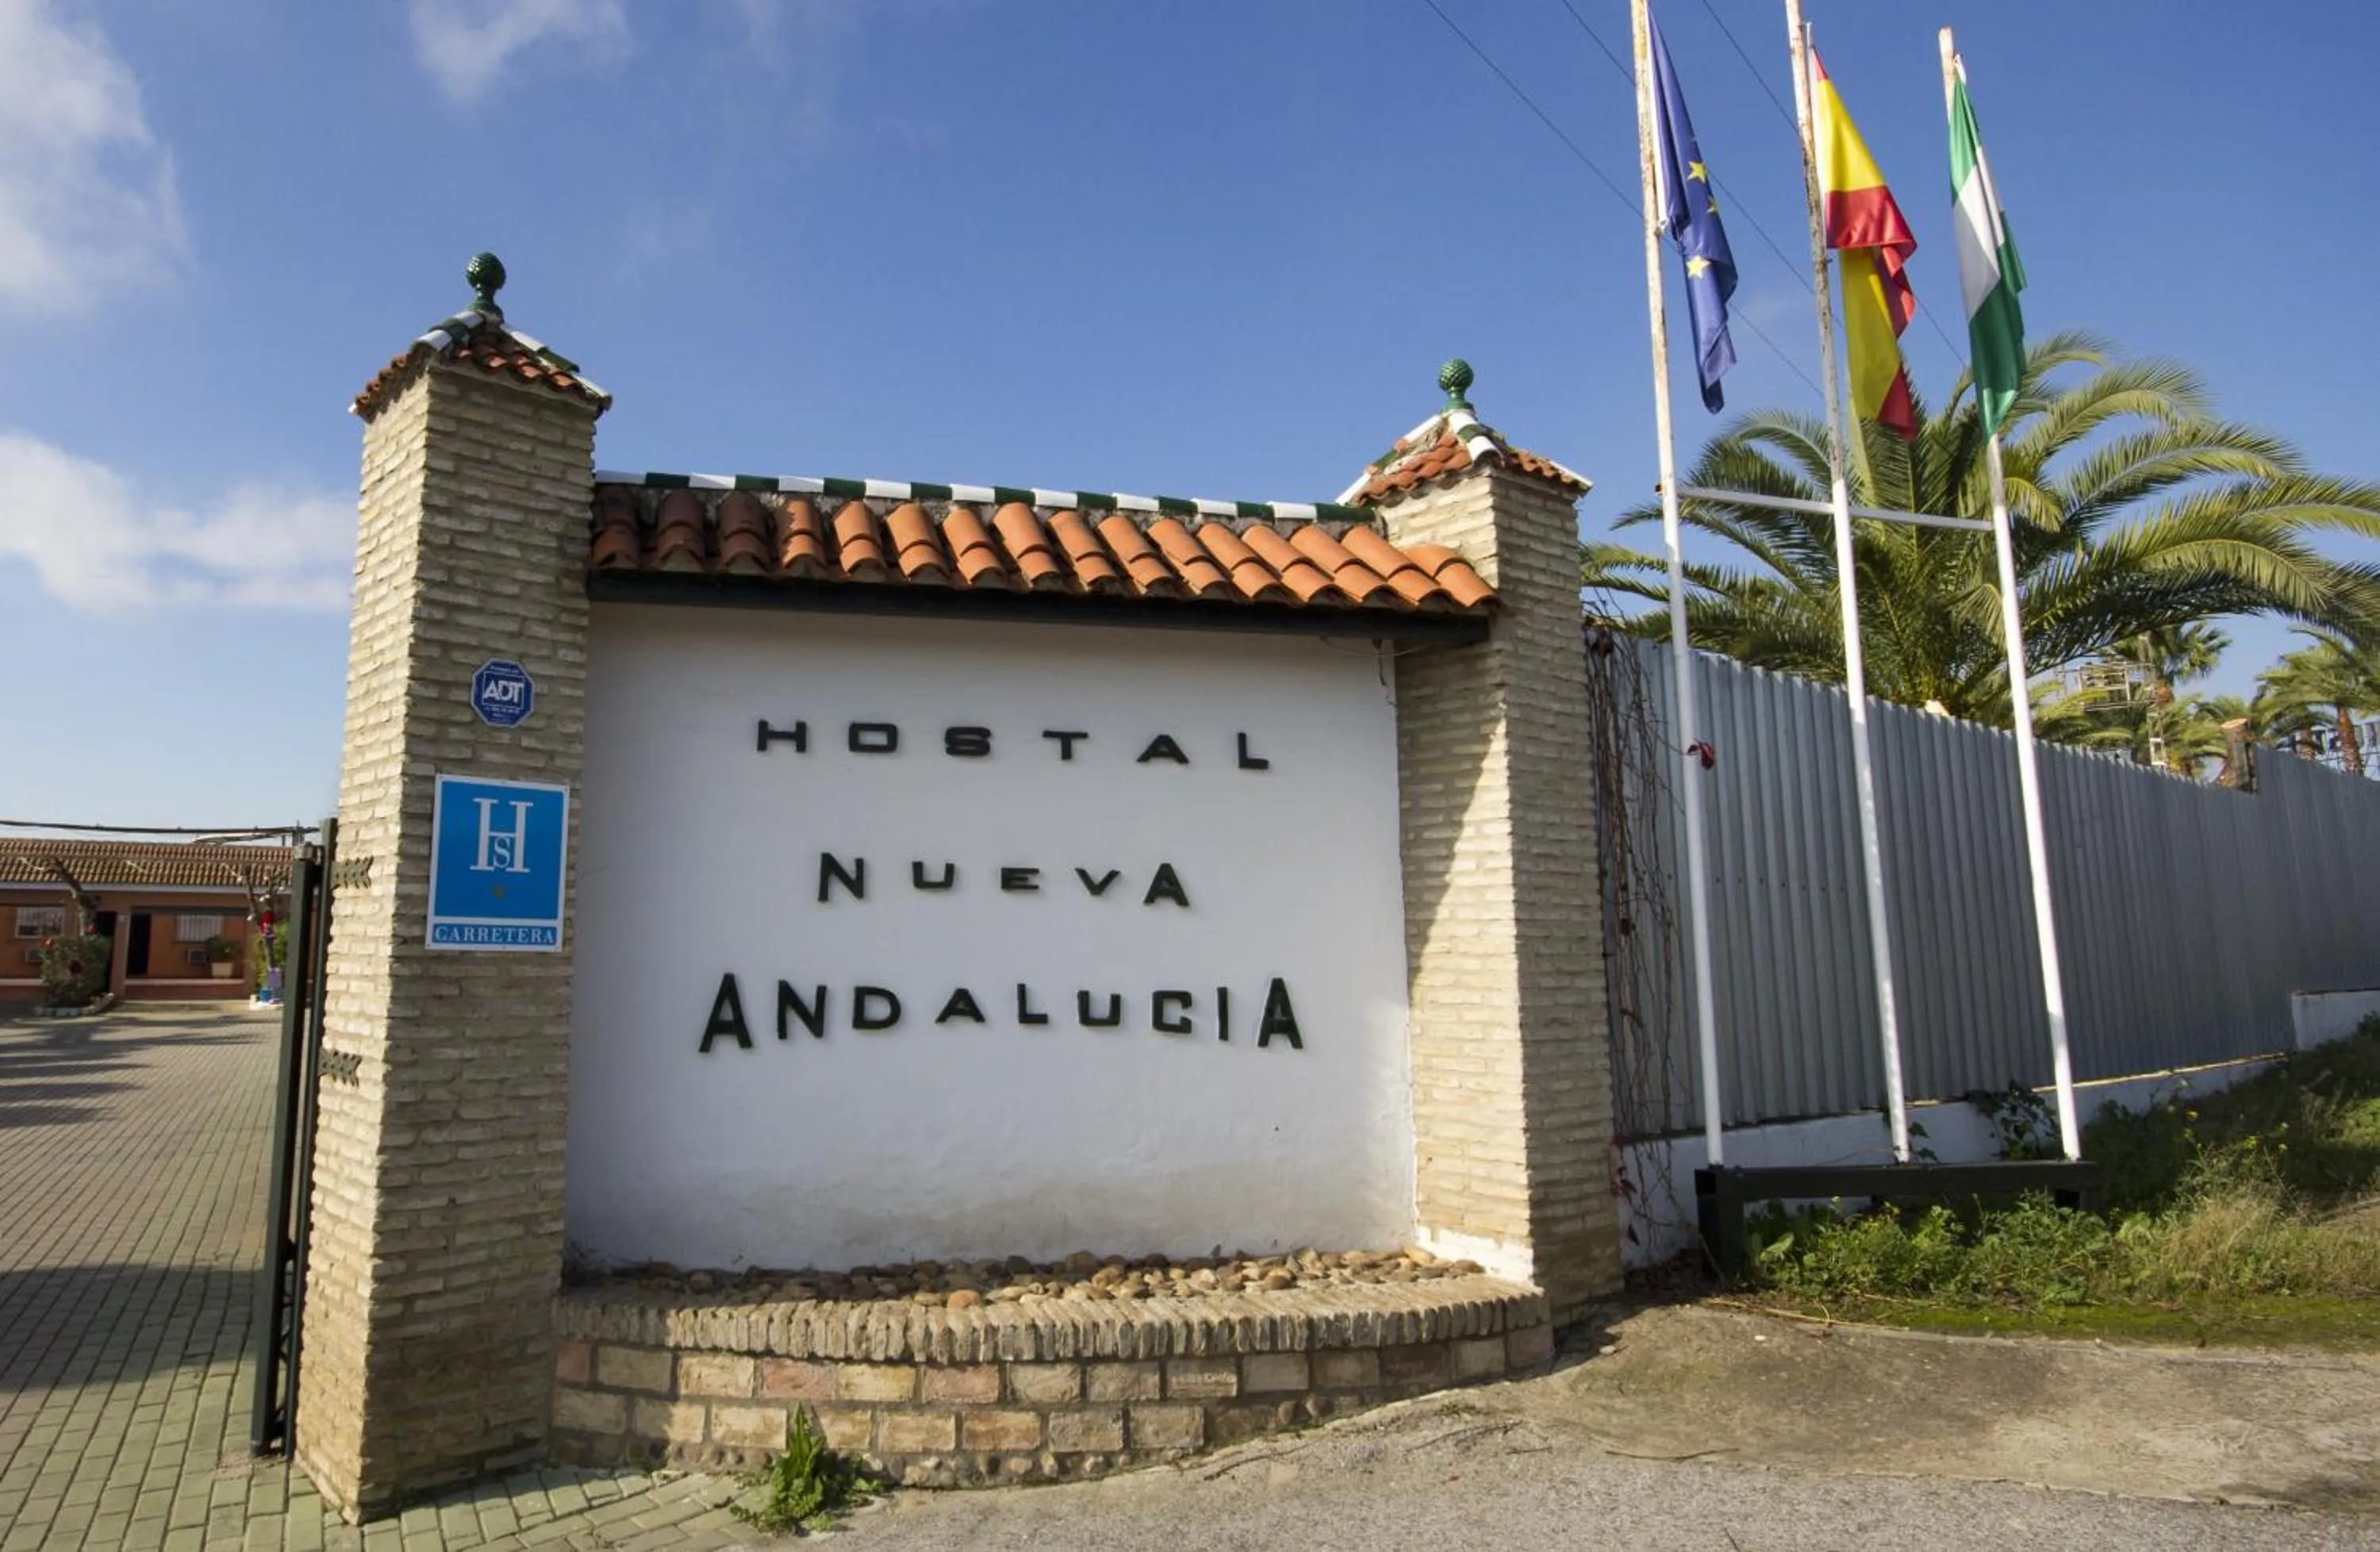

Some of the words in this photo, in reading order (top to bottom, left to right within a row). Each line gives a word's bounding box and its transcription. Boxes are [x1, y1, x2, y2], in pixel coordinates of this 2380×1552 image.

[482, 679, 524, 704] ADT
[756, 718, 1270, 771] HOSTAL
[817, 852, 1190, 908] NUEVA
[436, 926, 555, 944] CARRETERA
[697, 972, 1303, 1054] ANDALUCIA
